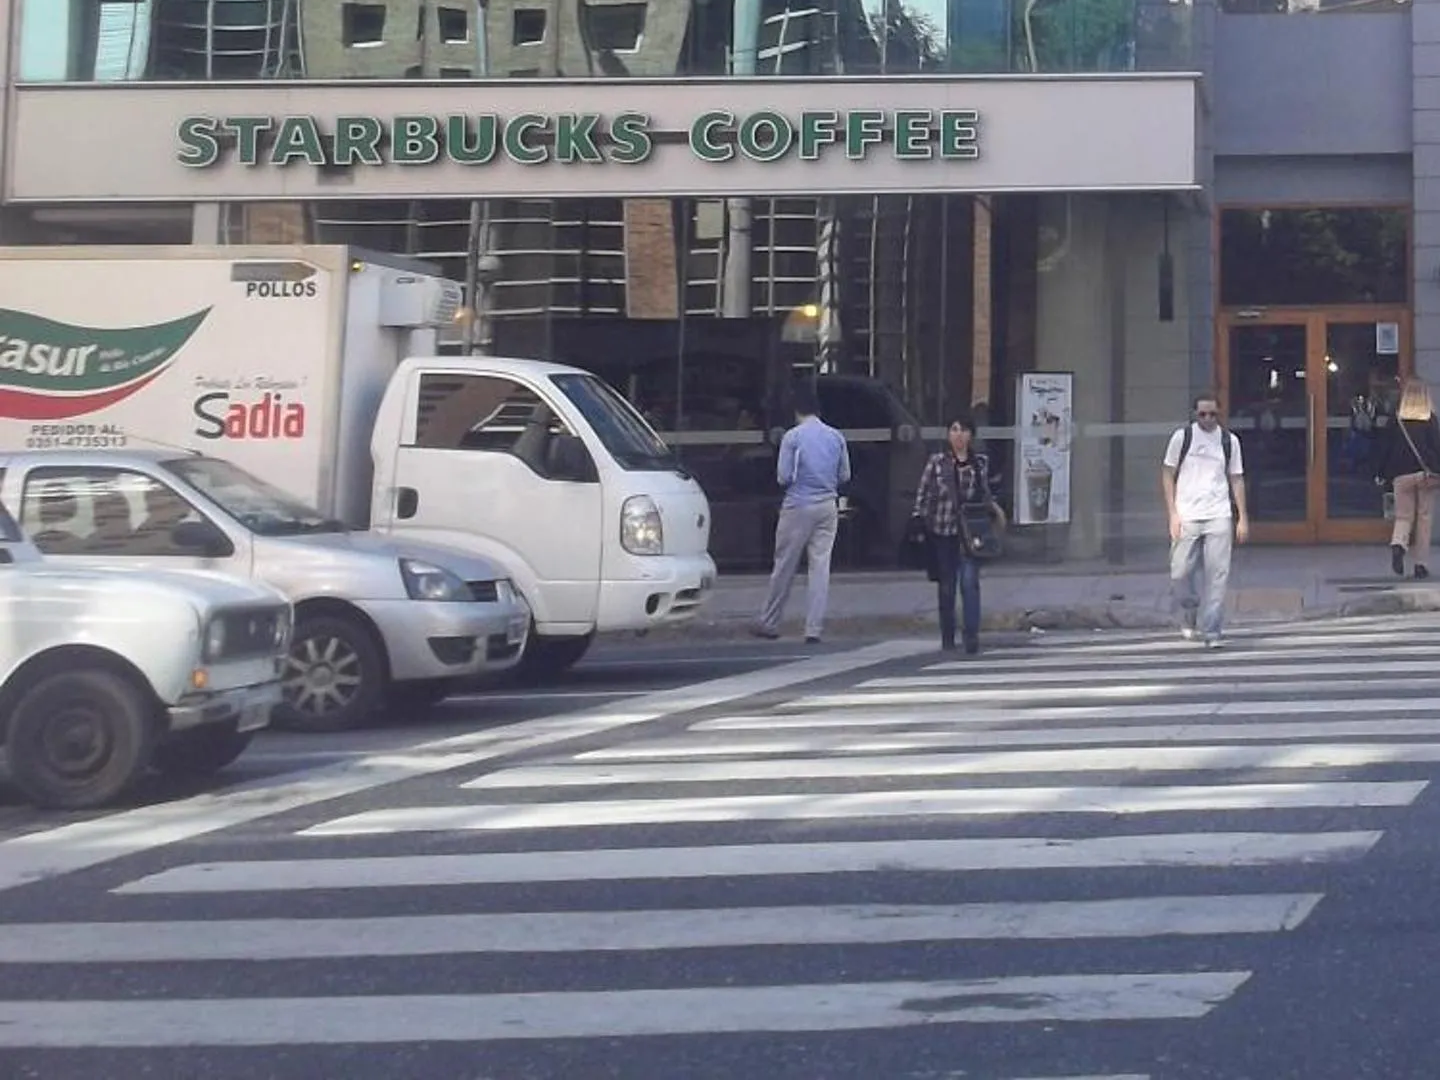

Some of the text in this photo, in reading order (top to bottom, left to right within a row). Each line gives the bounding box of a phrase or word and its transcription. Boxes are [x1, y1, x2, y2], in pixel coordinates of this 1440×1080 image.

[177, 110, 980, 167] STARBUCKS COFFEE
[246, 282, 317, 298] POLLOS
[31, 423, 95, 436] PEDIDOS
[194, 391, 305, 439] Sadia
